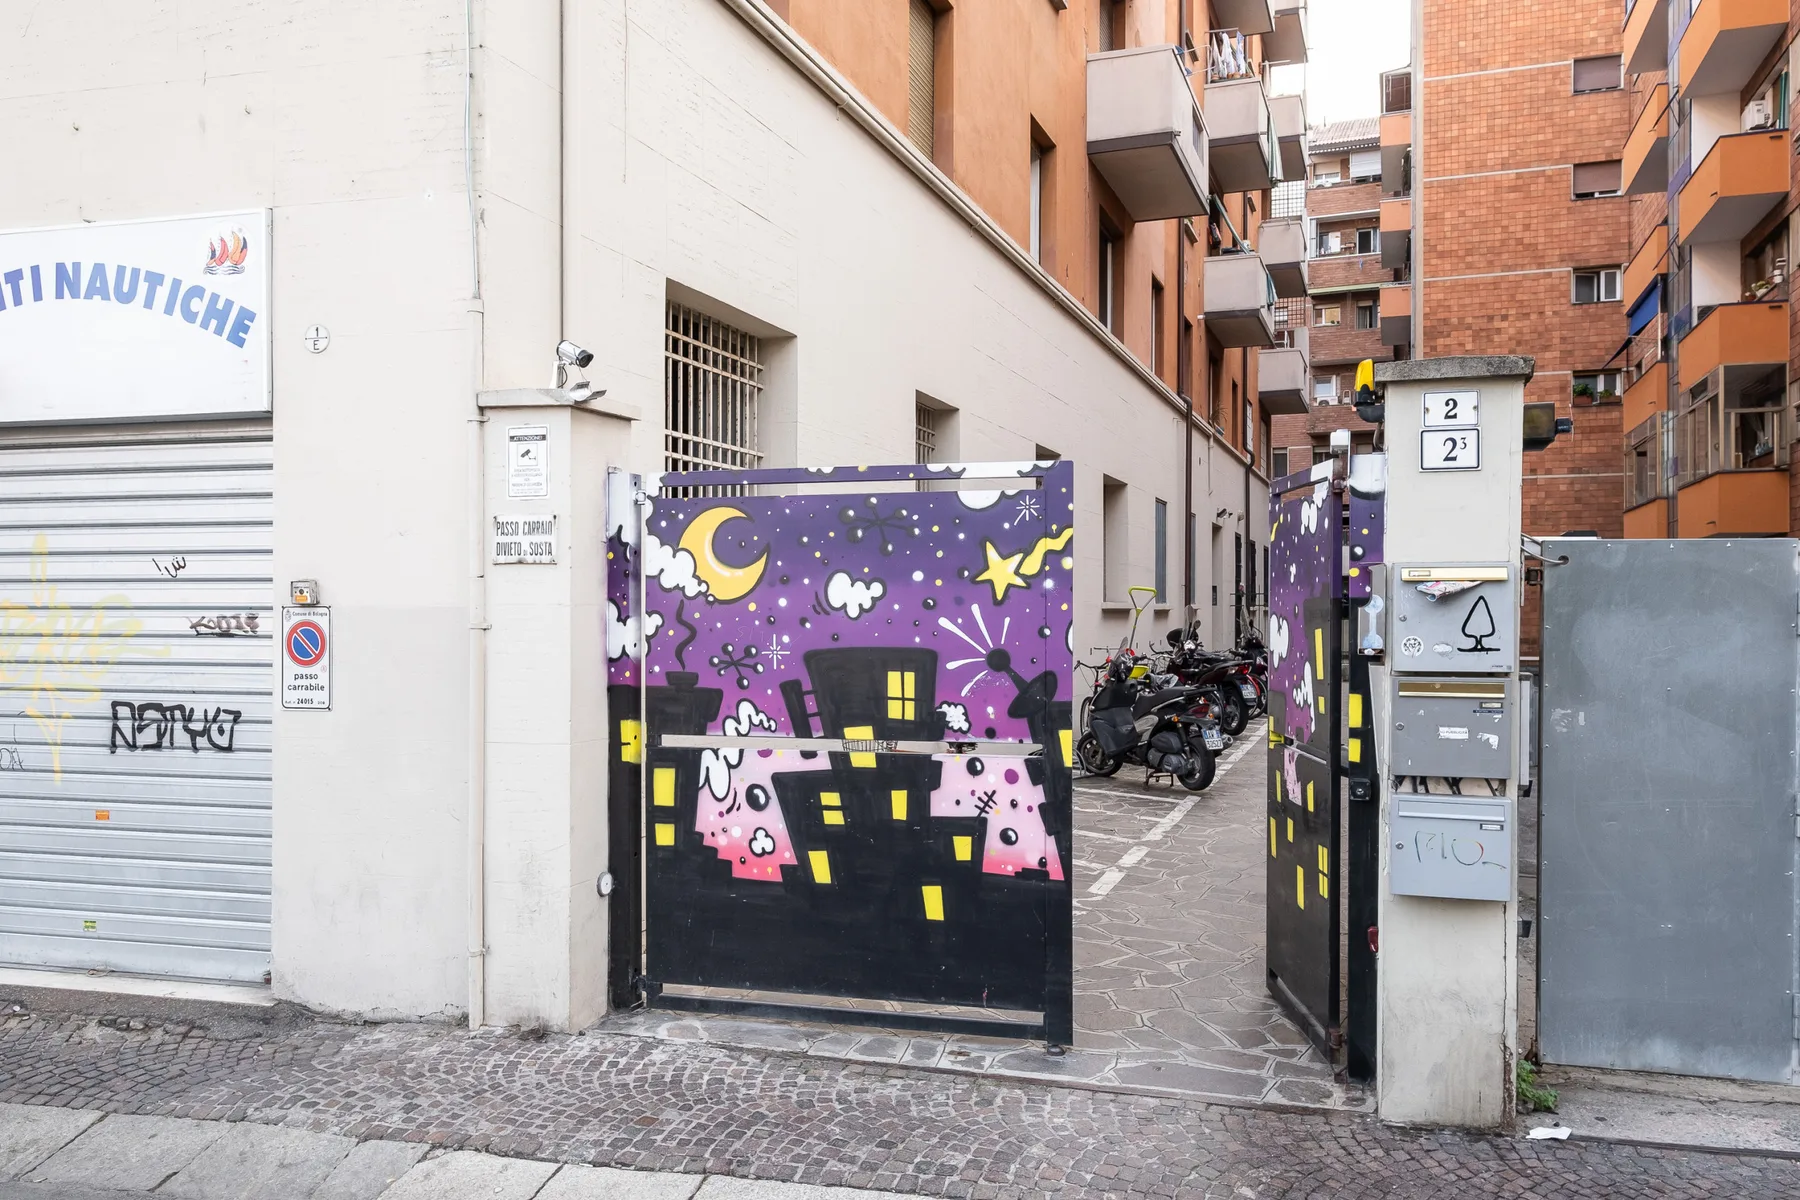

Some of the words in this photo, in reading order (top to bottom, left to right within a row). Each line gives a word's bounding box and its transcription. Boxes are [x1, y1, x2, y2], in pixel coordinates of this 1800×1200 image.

[0, 264, 43, 312] TI
[55, 261, 257, 349] NAUTICHE
[314, 326, 320, 338] 1
[312, 339, 320, 351] E
[1443, 397, 1459, 420] 2
[496, 520, 519, 537] PASSO
[522, 519, 553, 536] CARRAIO
[496, 541, 522, 557] DIVIETO
[529, 541, 553, 557] SOSTA
[293, 672, 319, 682] passo
[287, 682, 325, 692] carrabile
[297, 697, 314, 705] 24015
